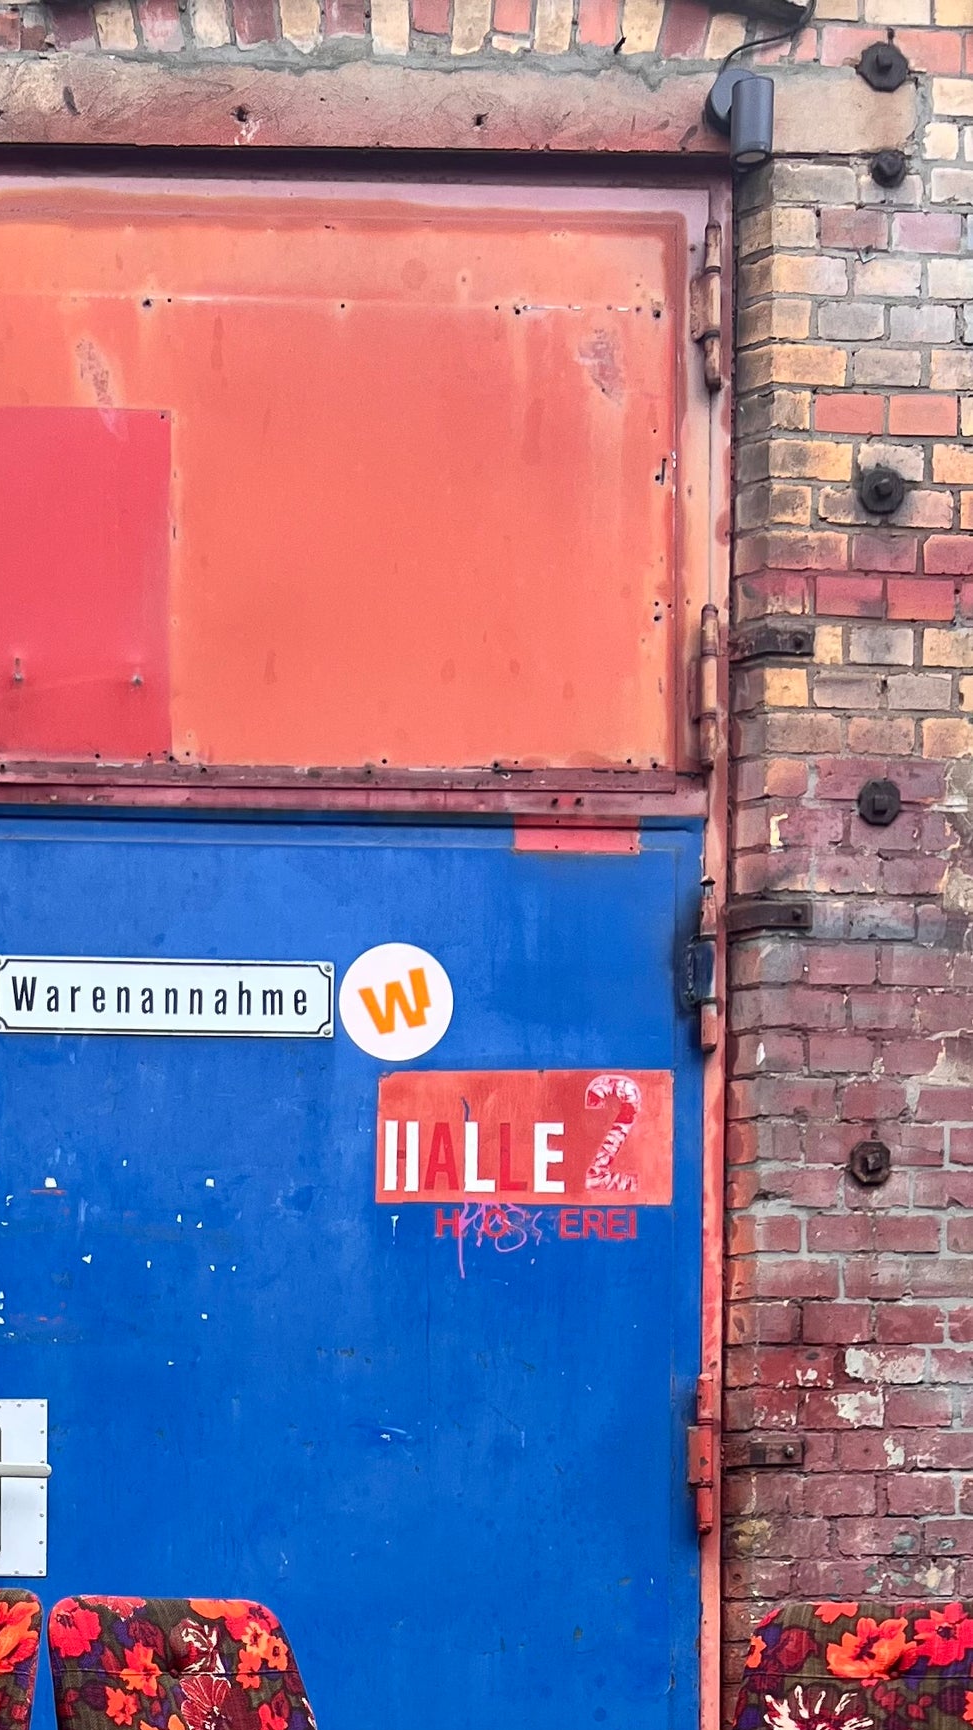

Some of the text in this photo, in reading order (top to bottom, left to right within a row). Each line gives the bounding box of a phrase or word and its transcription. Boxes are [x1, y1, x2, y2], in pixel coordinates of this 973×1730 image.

[11, 975, 308, 1017] Warenannahme
[358, 967, 432, 1036] W
[383, 1074, 642, 1193] HALLE 2
